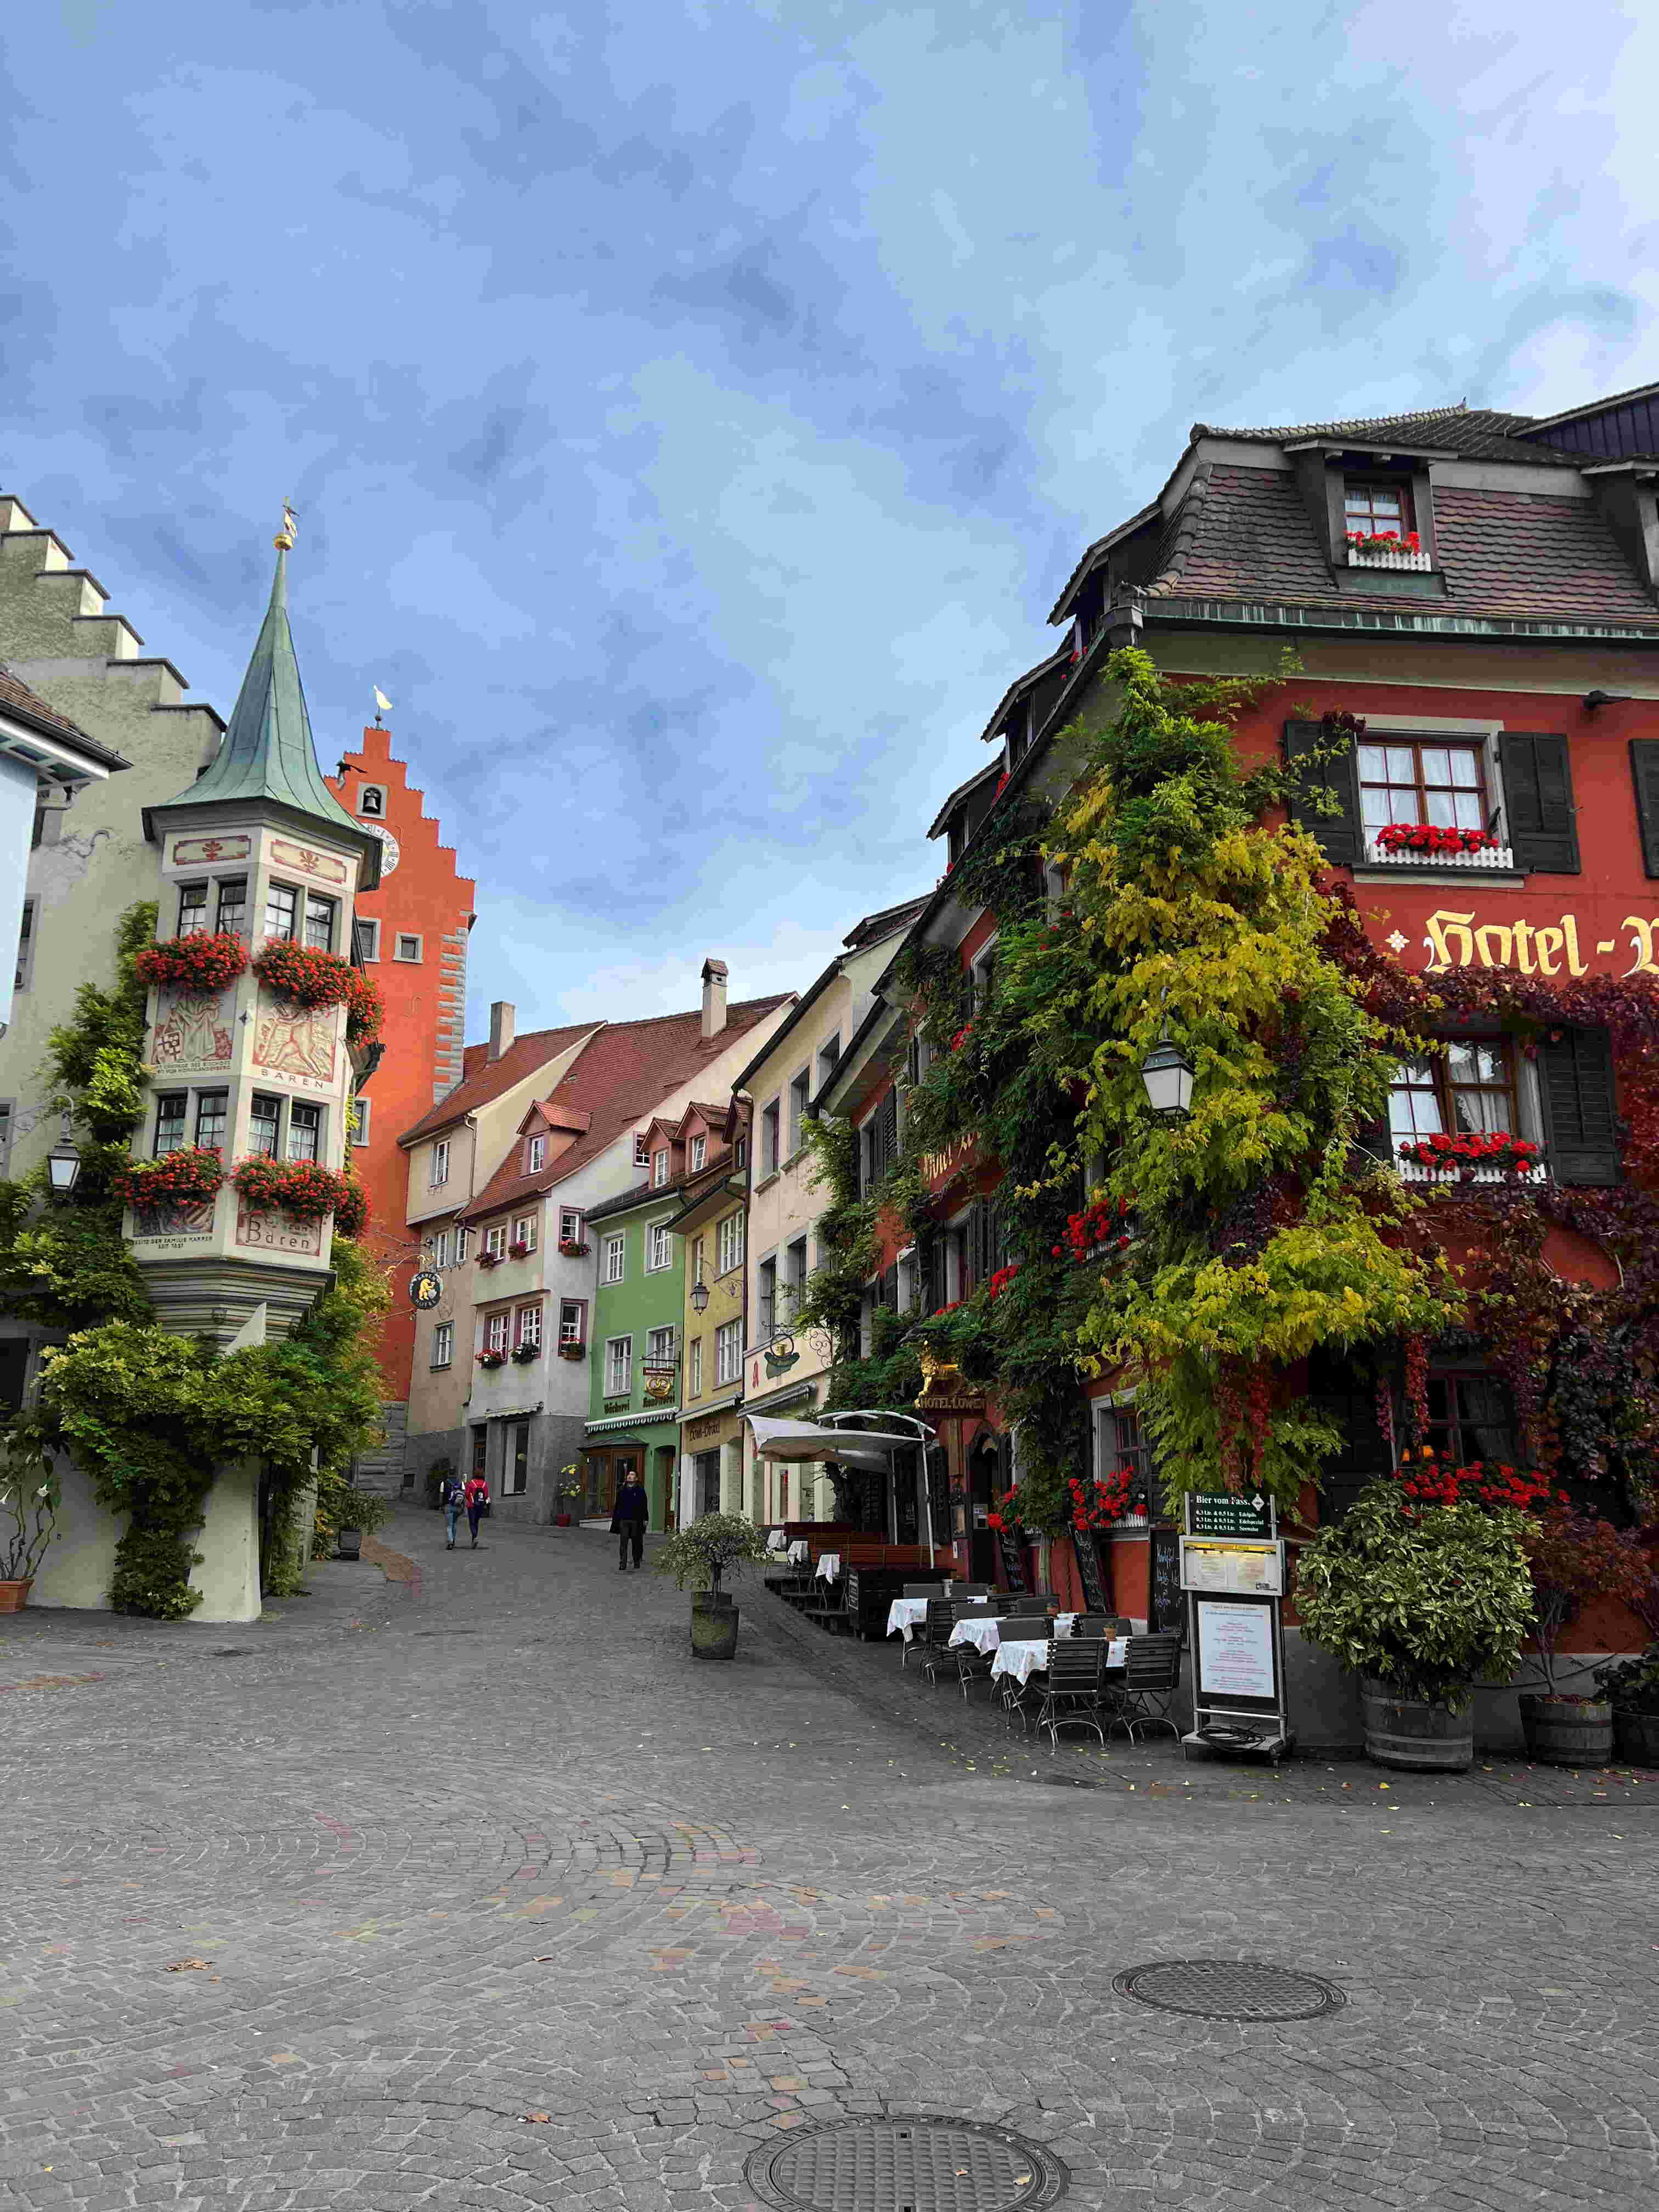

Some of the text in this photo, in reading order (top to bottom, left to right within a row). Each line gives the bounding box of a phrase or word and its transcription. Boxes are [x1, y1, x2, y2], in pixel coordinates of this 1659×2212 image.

[1423, 910, 1589, 976] Hotel
[1195, 1495, 1212, 1504] Bier
[1231, 1496, 1251, 1505] Fass.
